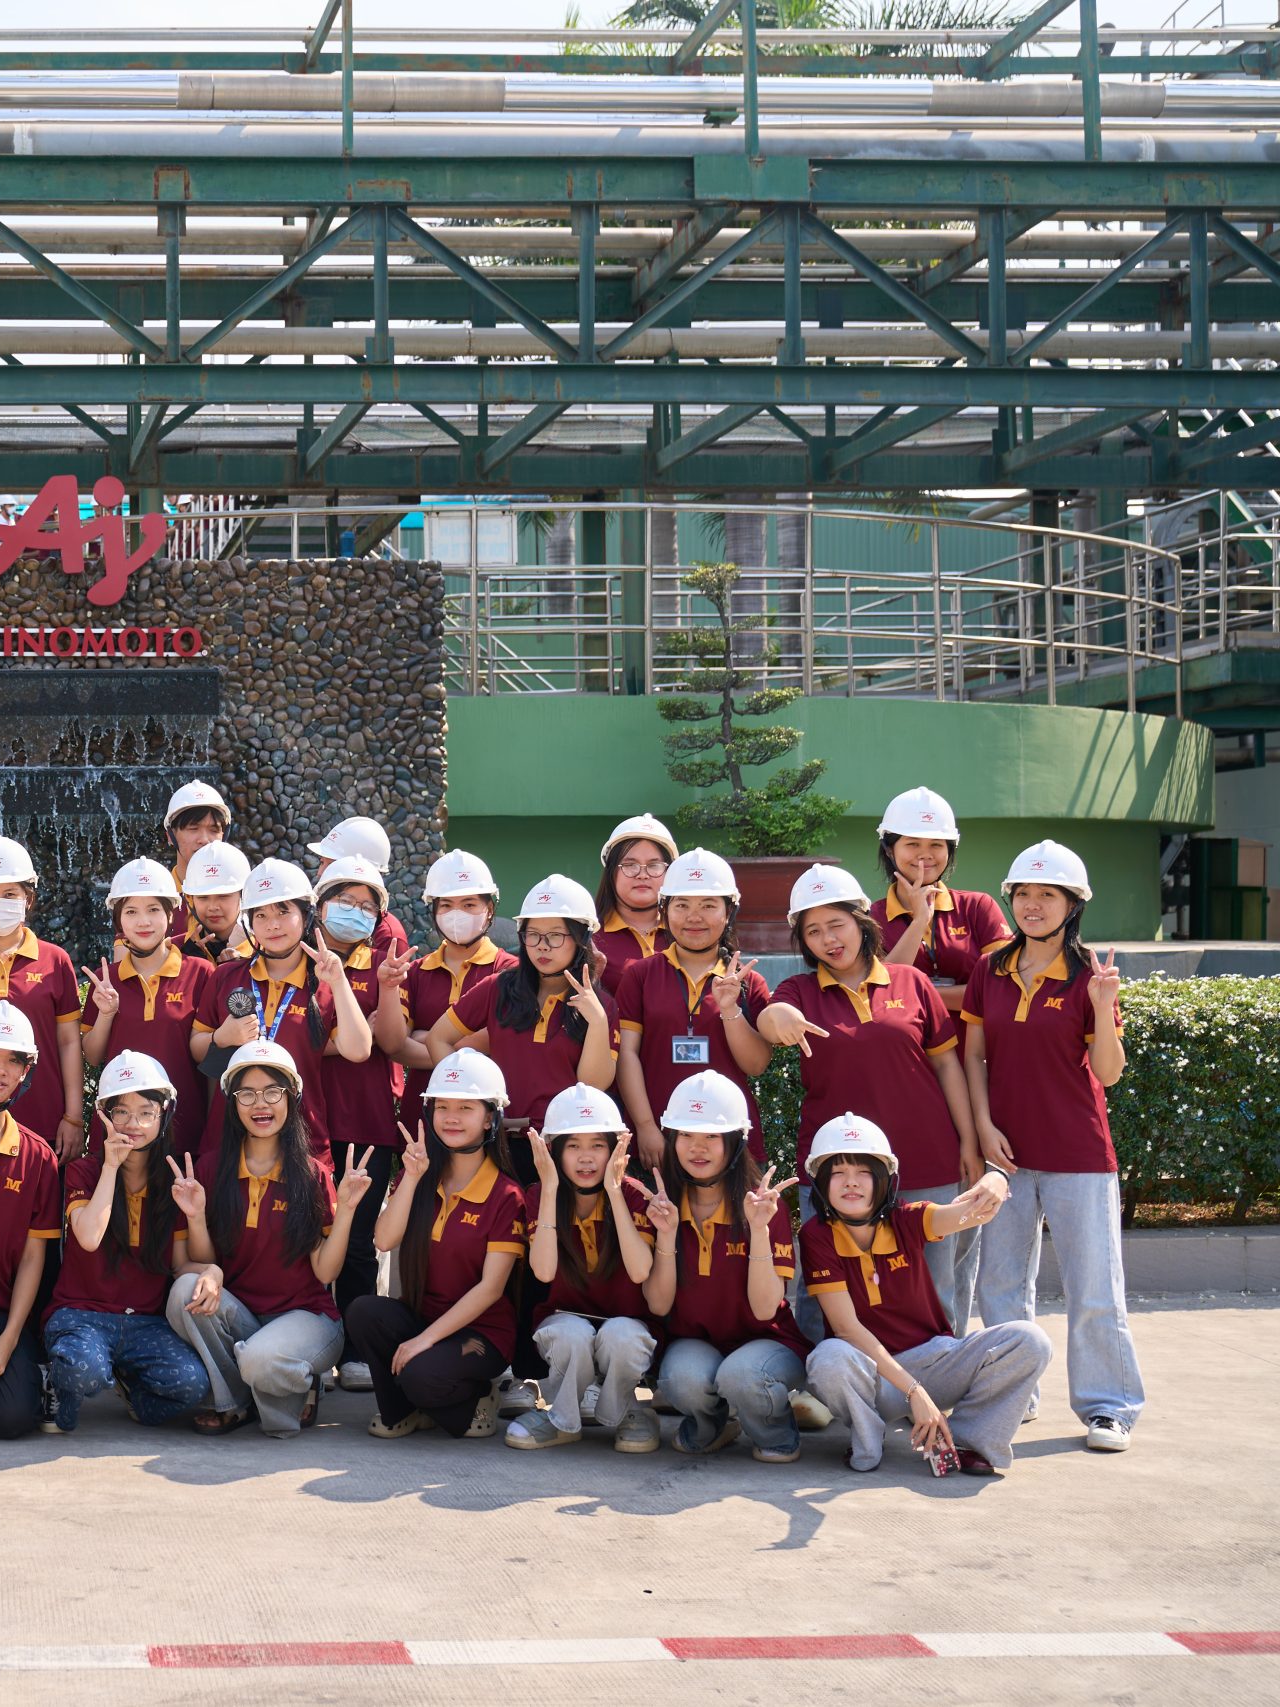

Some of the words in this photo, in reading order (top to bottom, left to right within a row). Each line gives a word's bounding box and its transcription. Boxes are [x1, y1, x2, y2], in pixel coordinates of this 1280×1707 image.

[948, 926, 967, 935] M
[26, 972, 42, 983] M
[352, 981, 368, 992] M
[166, 992, 183, 1003] M
[885, 999, 904, 1008] M
[1044, 997, 1064, 1010] M
[289, 1004, 307, 1016] M
[4, 1177, 22, 1192] M
[272, 1200, 288, 1212] M
[461, 1212, 480, 1226] M
[726, 1242, 745, 1256] M
[775, 1243, 792, 1259] M
[887, 1254, 909, 1271] M
